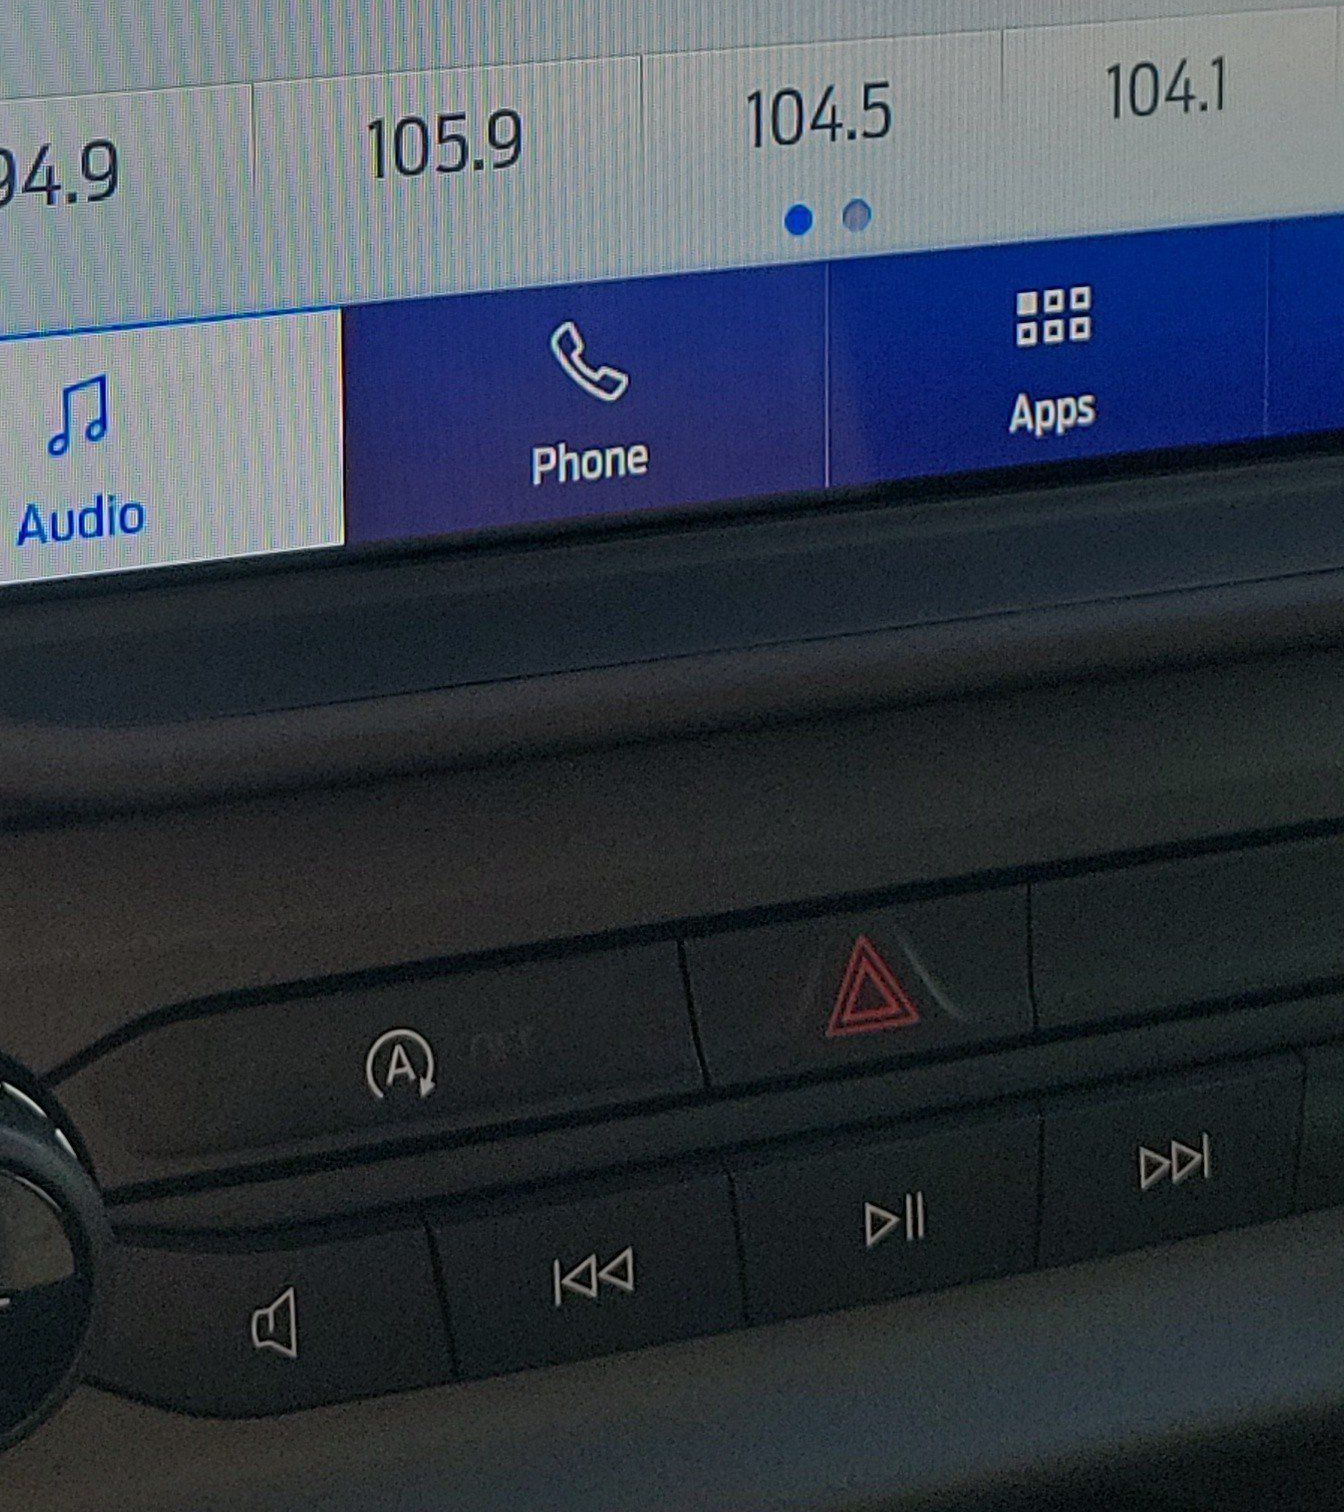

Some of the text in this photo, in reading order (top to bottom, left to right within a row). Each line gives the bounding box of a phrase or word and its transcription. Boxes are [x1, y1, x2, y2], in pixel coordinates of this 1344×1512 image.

[747, 80, 892, 149] 104.5
[1107, 55, 1225, 120] 104.1
[368, 108, 522, 179] 105.9
[1009, 393, 1095, 438] Apps
[532, 443, 648, 486] Phone
[16, 493, 145, 547] Audio
